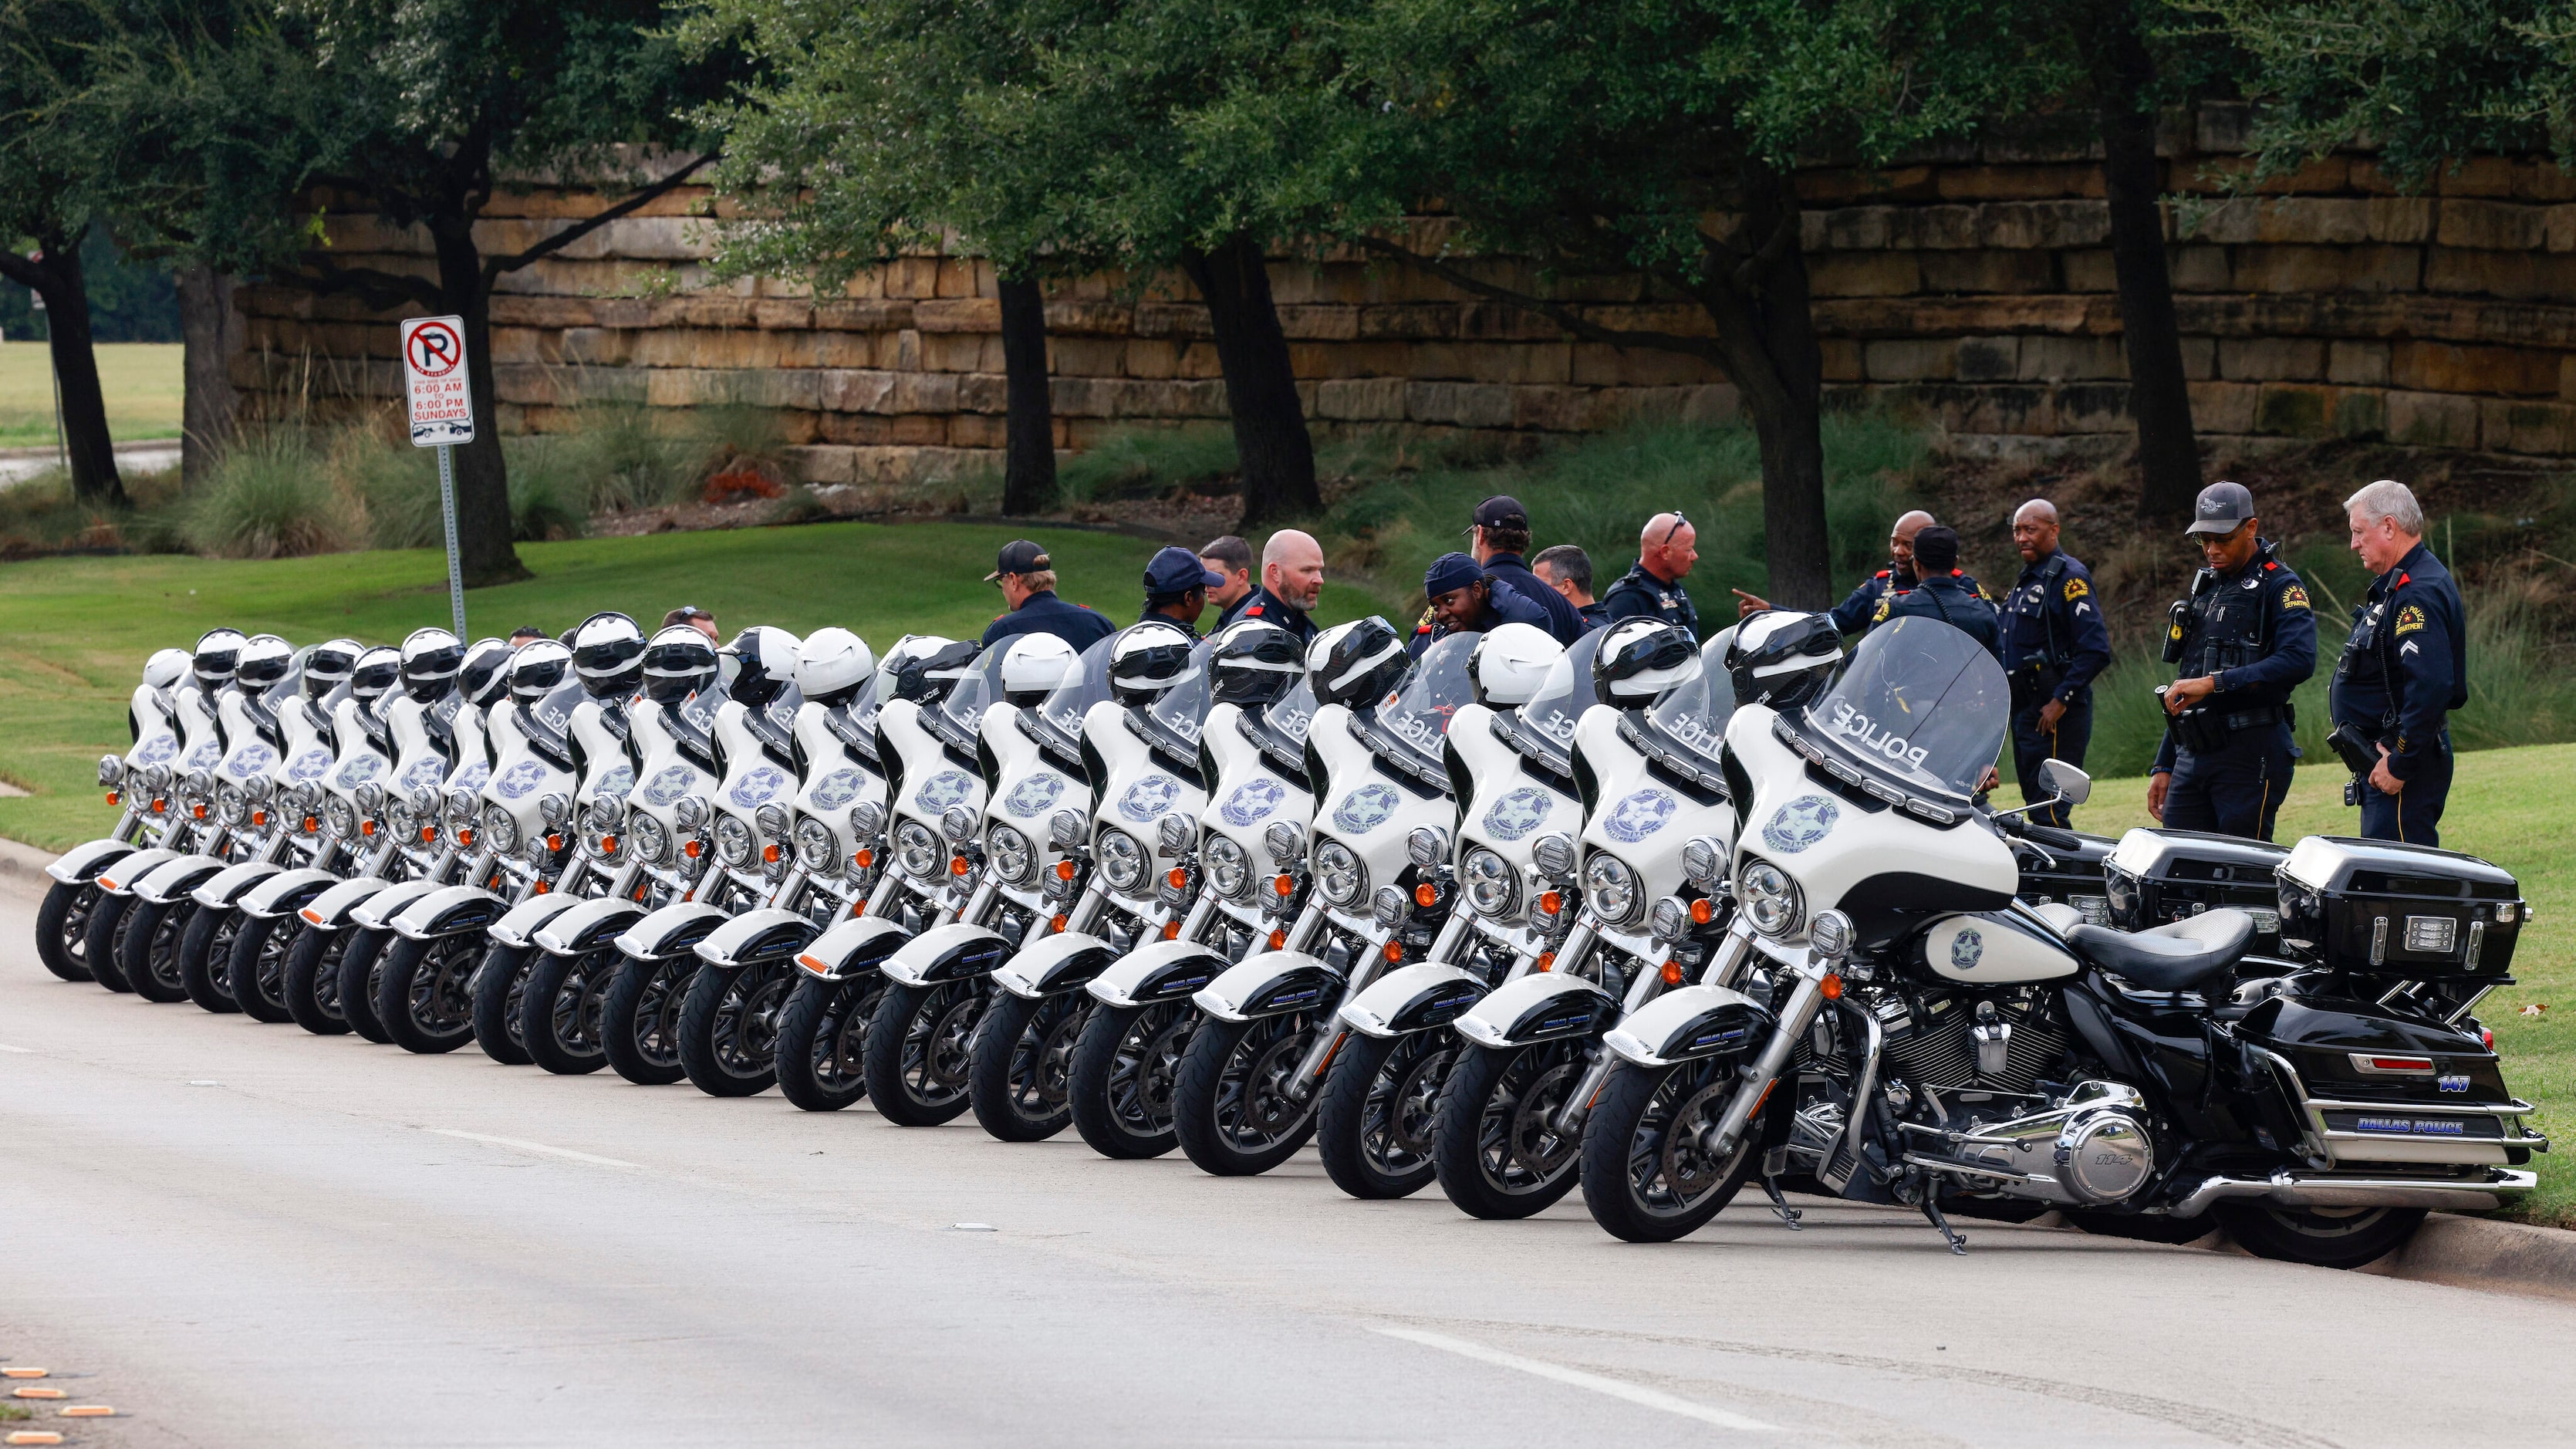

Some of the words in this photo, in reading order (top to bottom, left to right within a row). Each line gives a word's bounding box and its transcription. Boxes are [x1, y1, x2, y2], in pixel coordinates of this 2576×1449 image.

[414, 383, 440, 394] 6:00
[445, 382, 462, 392] AM
[416, 400, 441, 410] 6:00
[446, 398, 463, 407] PM
[414, 408, 467, 421] SUNDAYS
[2282, 586, 2297, 603] DALLAS
[2395, 607, 2407, 629] DALLAS
[2409, 605, 2425, 623] POLICE
[2395, 623, 2424, 636] DEPARTMENT
[944, 772, 972, 789] POLICE
[1036, 772, 1064, 791] POLICE
[1149, 775, 1180, 794] POLICE
[1255, 779, 1285, 799] POLICE
[1368, 784, 1399, 805] POLICE
[1518, 788, 1552, 809] POLICE
[1641, 789, 1676, 811] POLICE
[1030, 802, 1052, 812] TEXAS
[1146, 805, 1170, 816] TEXAS
[1247, 809, 1271, 821] TEXAS
[1801, 795, 1838, 818] POLICE
[1361, 817, 1386, 828] TEXAS
[1514, 821, 1540, 834] TEXAS
[1769, 808, 1784, 832] DALLAS
[1482, 819, 1518, 841] DEPARTMENT
[1603, 820, 1638, 843] DEPARTMENT
[1635, 824, 1662, 836] TEXAS
[1762, 829, 1800, 853] DEPARTMENT
[1795, 833, 1824, 846] TEXAS
[2437, 1075, 2470, 1093] 147
[2358, 1118, 2411, 1133] DALLAS
[2413, 1120, 2464, 1135] POLICE
[2095, 1153, 2133, 1165] 114
